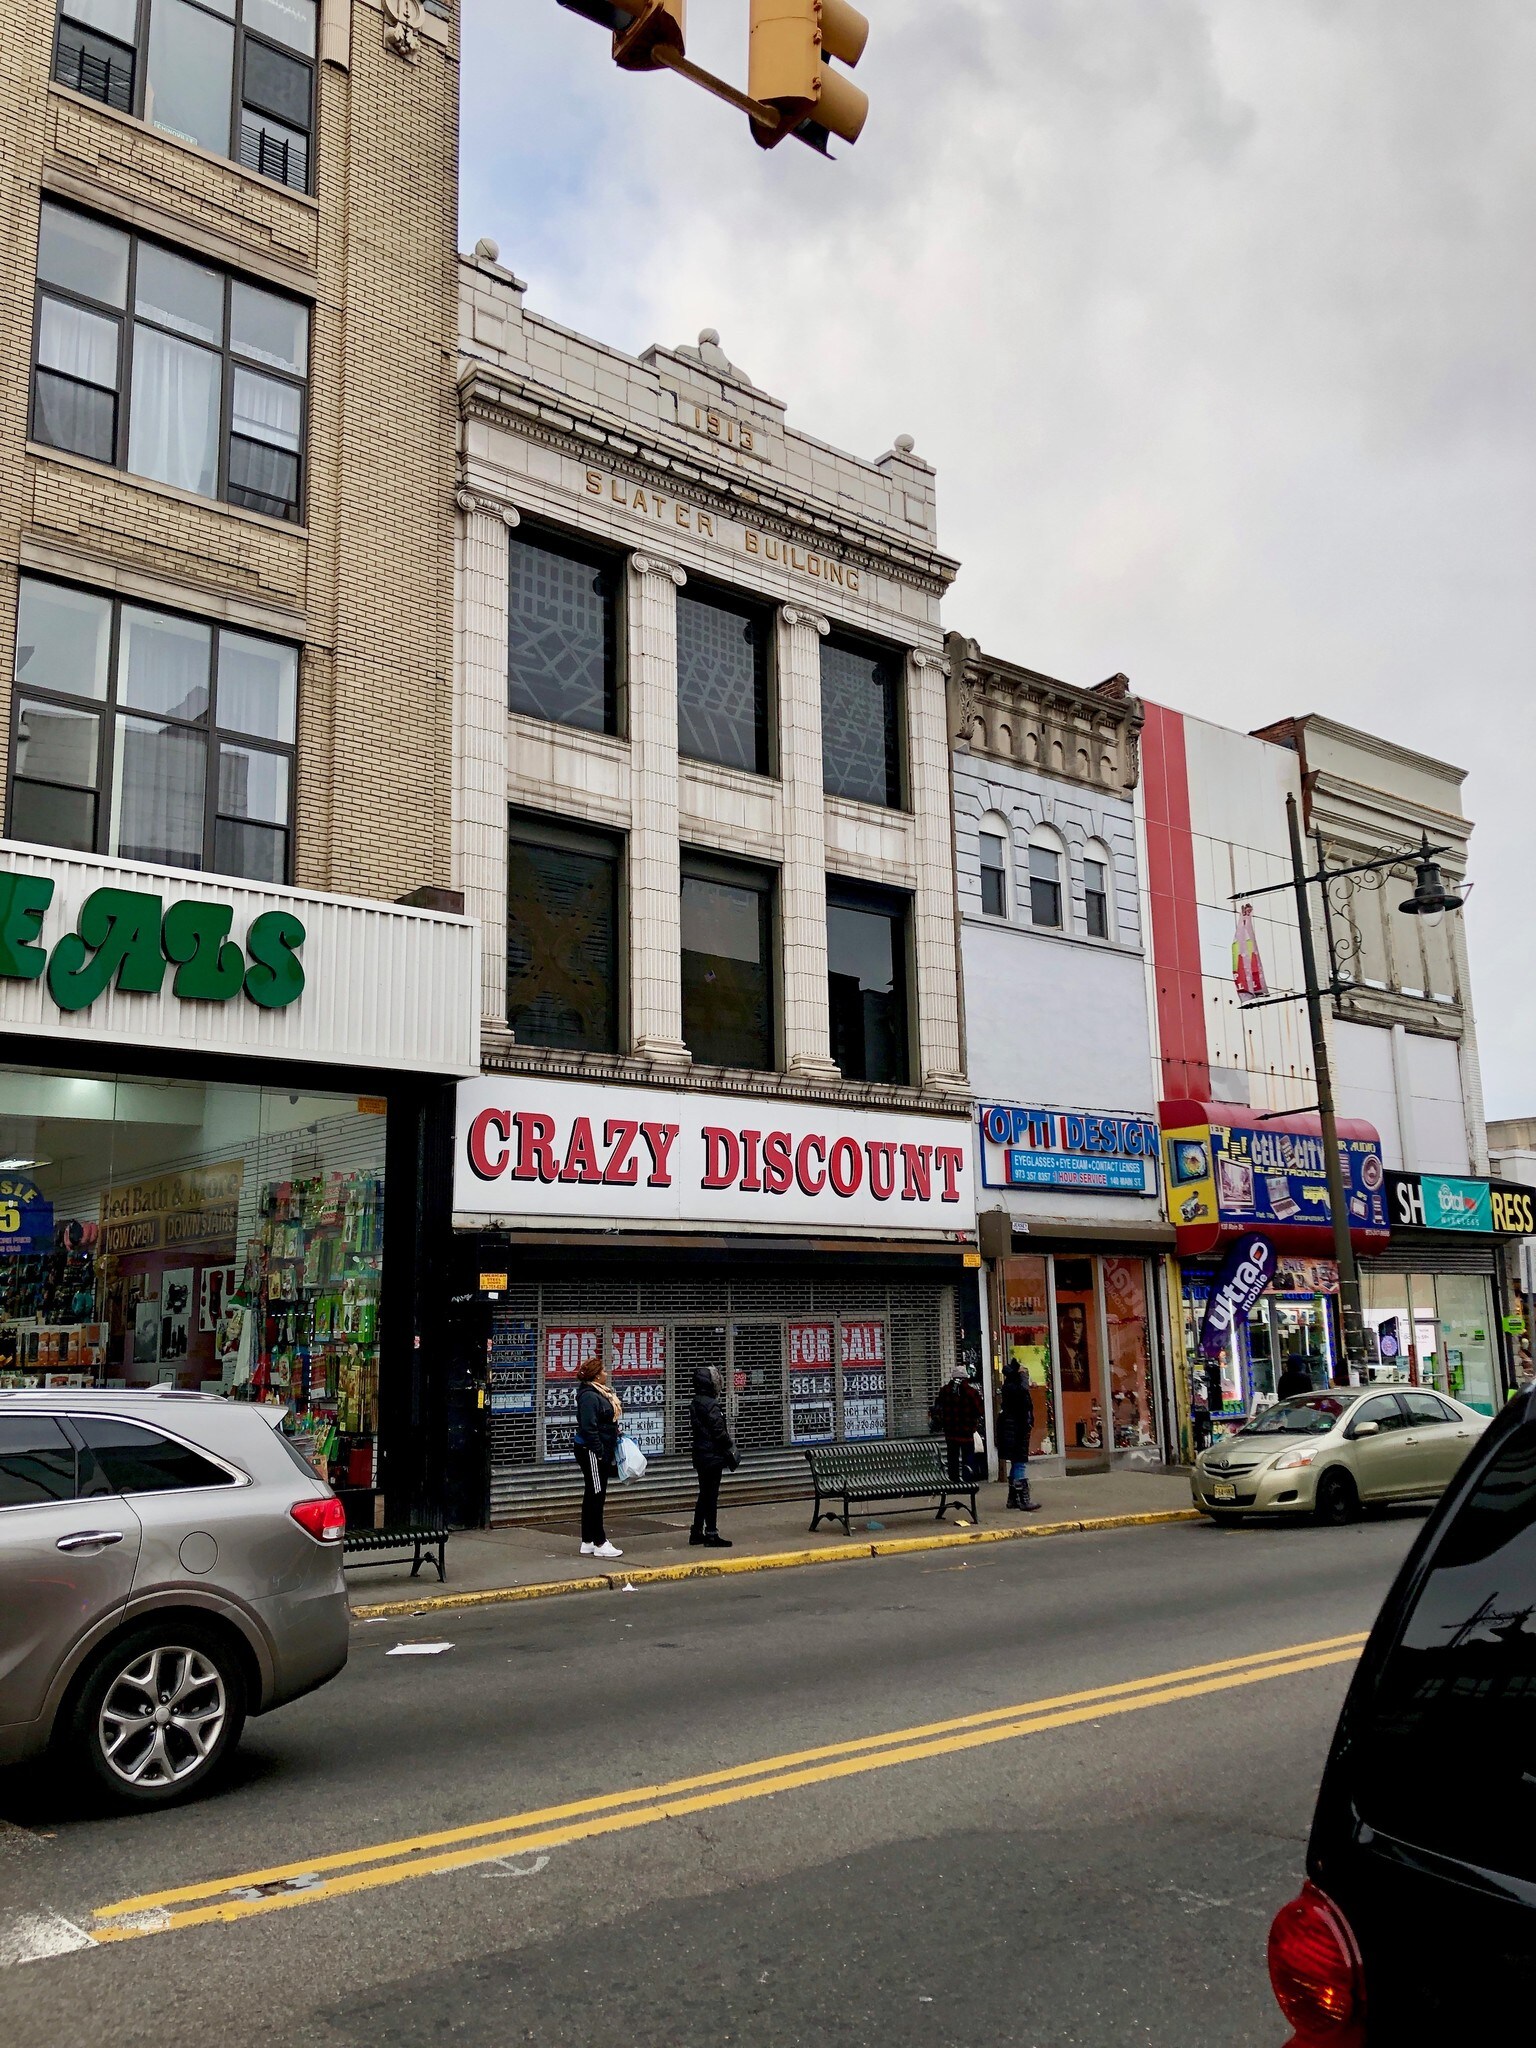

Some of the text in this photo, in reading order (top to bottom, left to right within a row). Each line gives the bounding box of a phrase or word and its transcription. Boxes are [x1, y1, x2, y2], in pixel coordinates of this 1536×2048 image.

[694, 408, 754, 450] 1913
[585, 470, 860, 592] SLATER BUILDING
[984, 1107, 1160, 1157] OPTI DESIGN
[1251, 1130, 1327, 1171] CELL CITY
[1350, 1141, 1377, 1153] AUDIO
[467, 1107, 963, 1203] CRAZY DISCOUNT
[1014, 1154, 1140, 1173] EYEGLASSES EYE EXAM CONTACT LENSES
[1254, 1165, 1328, 1179] ELECTRONICS
[132, 1181, 168, 1214] Bath
[172, 1178, 185, 1207] &
[189, 1172, 239, 1204] More
[1014, 1169, 1026, 1179] 973
[1059, 1171, 1078, 1184] HOUR
[1079, 1172, 1107, 1186] SERVICE
[1490, 1191, 1535, 1234] RESS
[129, 1221, 155, 1248] OPEN
[1208, 1261, 1259, 1330] ultra
[1241, 1273, 1268, 1313] mobile
[547, 1332, 597, 1372] FOR
[791, 1327, 830, 1363] FOR
